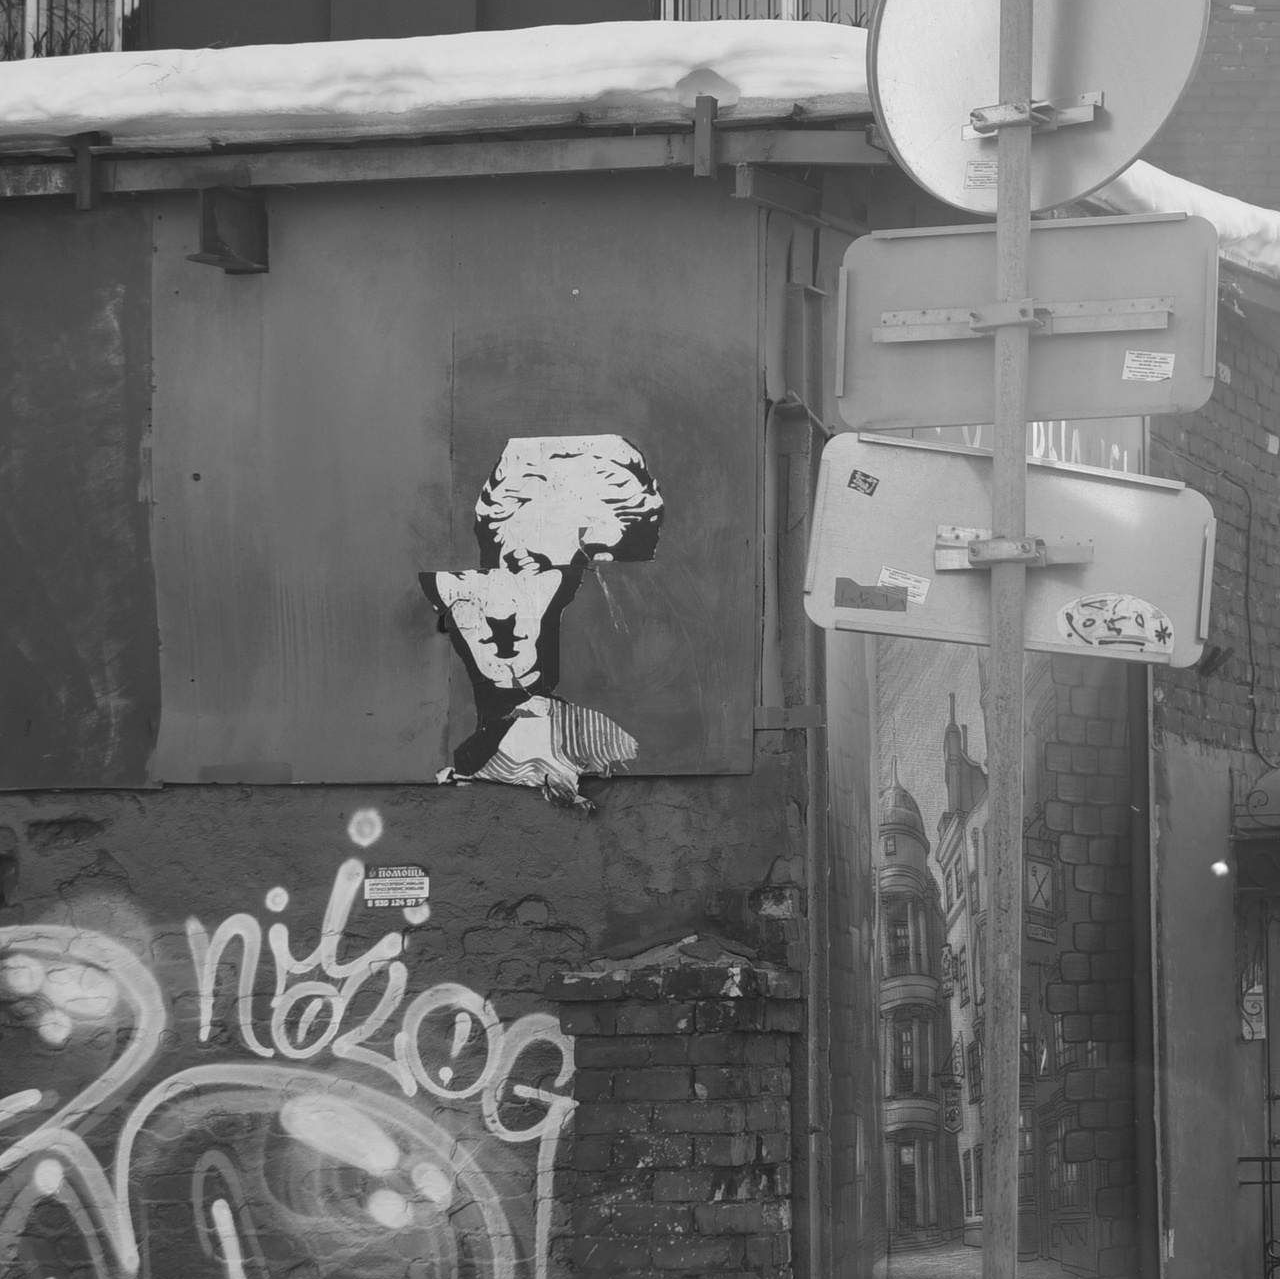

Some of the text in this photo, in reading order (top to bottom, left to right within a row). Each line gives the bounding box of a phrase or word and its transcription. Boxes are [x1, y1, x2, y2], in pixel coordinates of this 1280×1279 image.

[378, 869, 425, 878] ПОМОЩЬ
[367, 899, 373, 907] 8
[390, 899, 405, 907] 124
